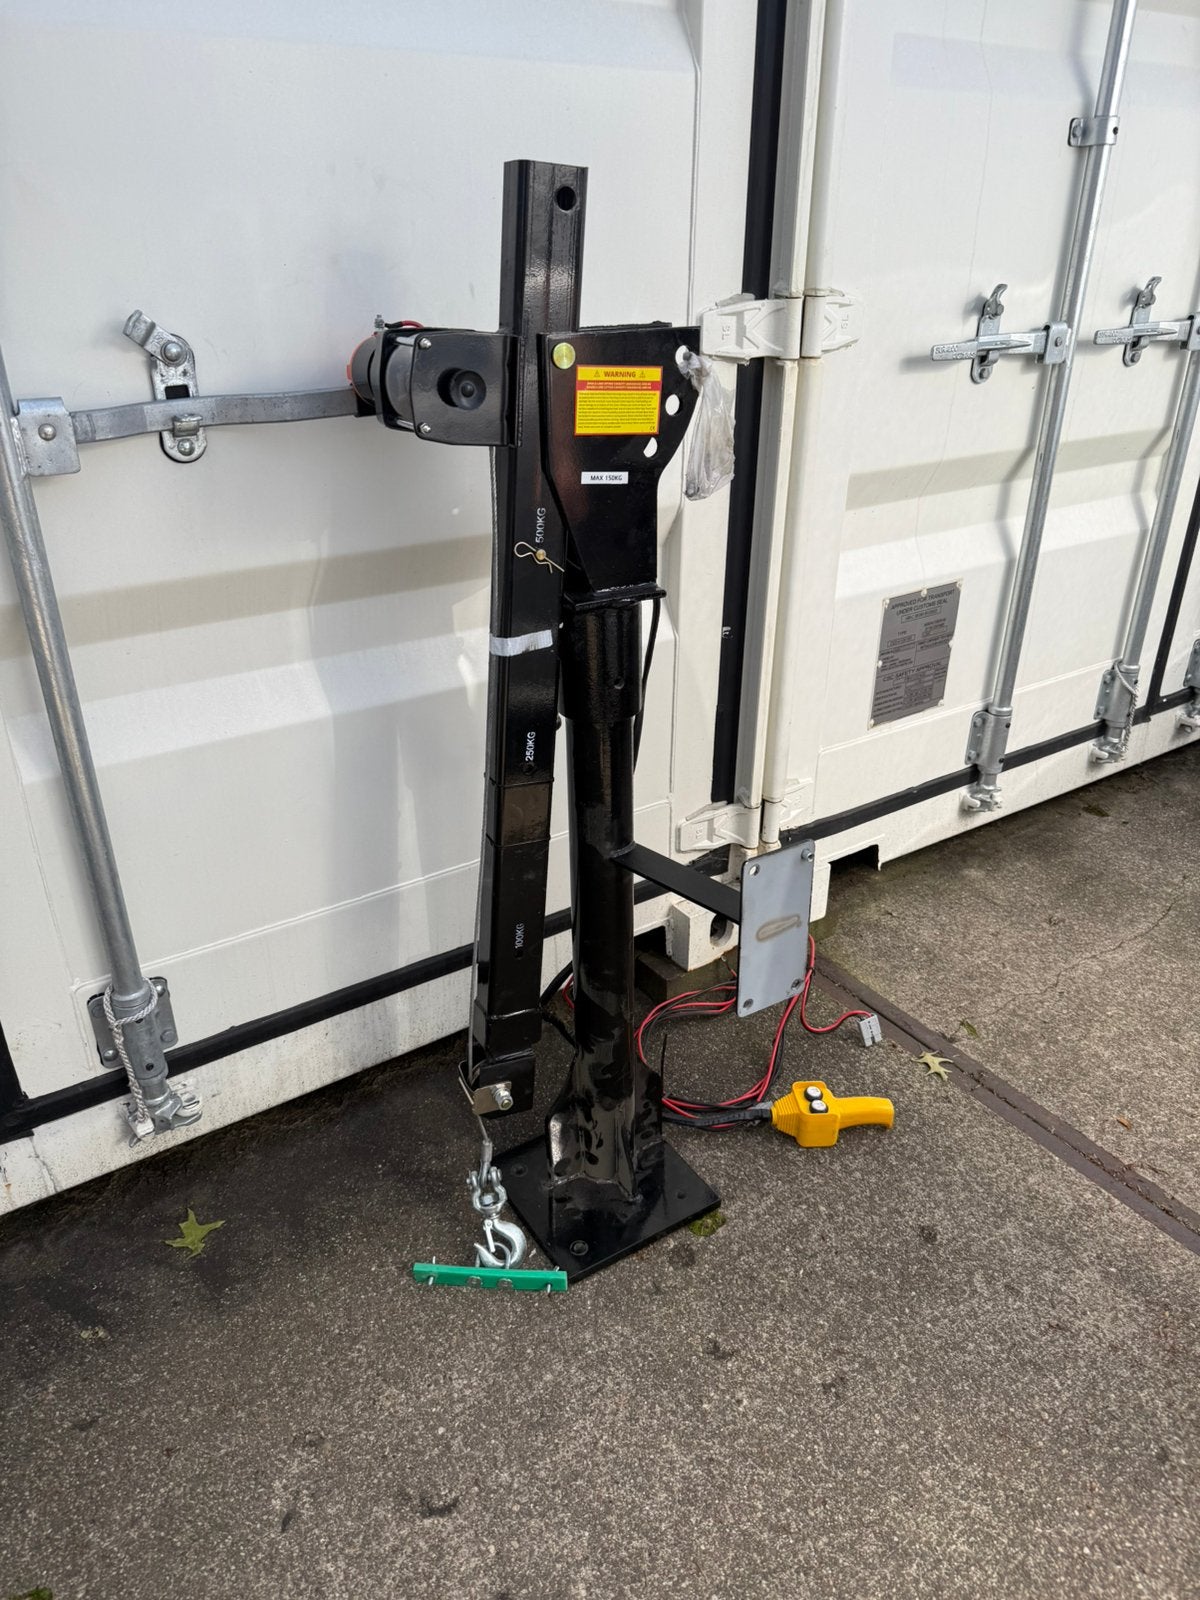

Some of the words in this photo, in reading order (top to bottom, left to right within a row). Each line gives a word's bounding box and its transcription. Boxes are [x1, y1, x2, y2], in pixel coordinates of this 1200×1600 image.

[603, 370, 637, 378] WARNING
[535, 507, 546, 544] 500KG
[891, 598, 917, 610] APPROVED
[928, 589, 955, 600] TRANSPORT
[896, 606, 913, 616] UNDER
[913, 601, 936, 611] CUSTOMS
[936, 598, 948, 606] SEAL
[896, 669, 915, 678] SAFETY
[525, 731, 536, 762] 250KG
[515, 923, 525, 949] 100KG
